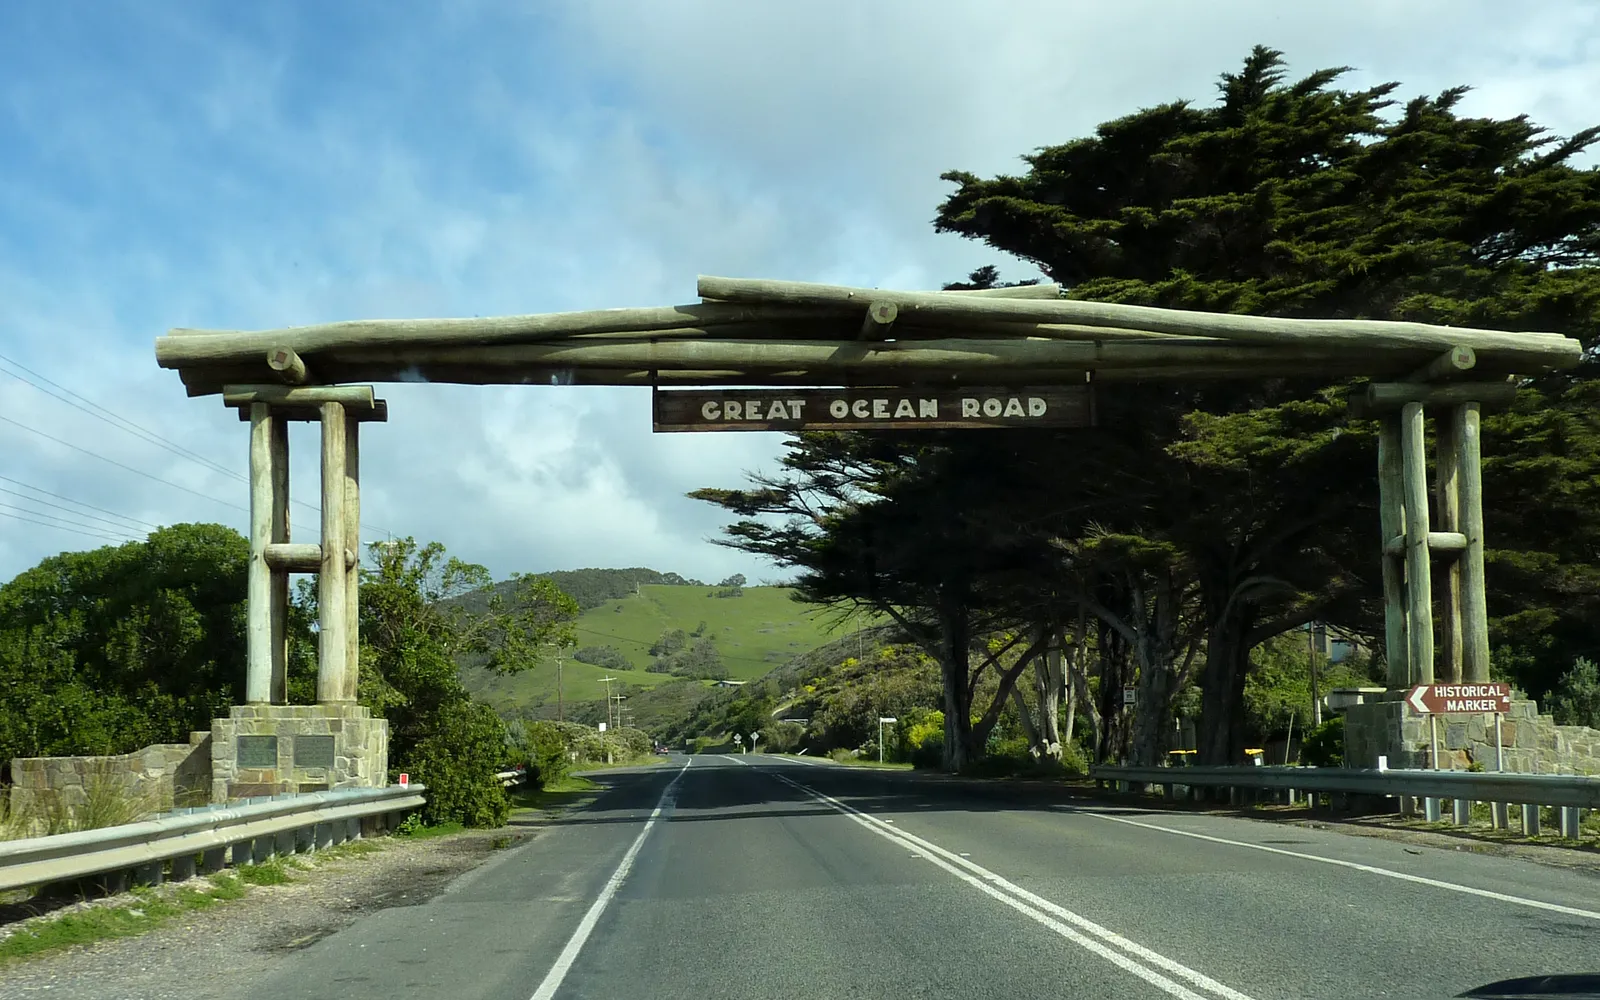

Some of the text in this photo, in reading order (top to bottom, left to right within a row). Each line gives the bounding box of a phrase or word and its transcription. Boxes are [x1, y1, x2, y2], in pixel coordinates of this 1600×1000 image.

[701, 396, 1048, 420] GREAT OCEAN ROAD
[1434, 685, 1504, 697] HISTORICAL
[1447, 700, 1497, 711] MARKER
